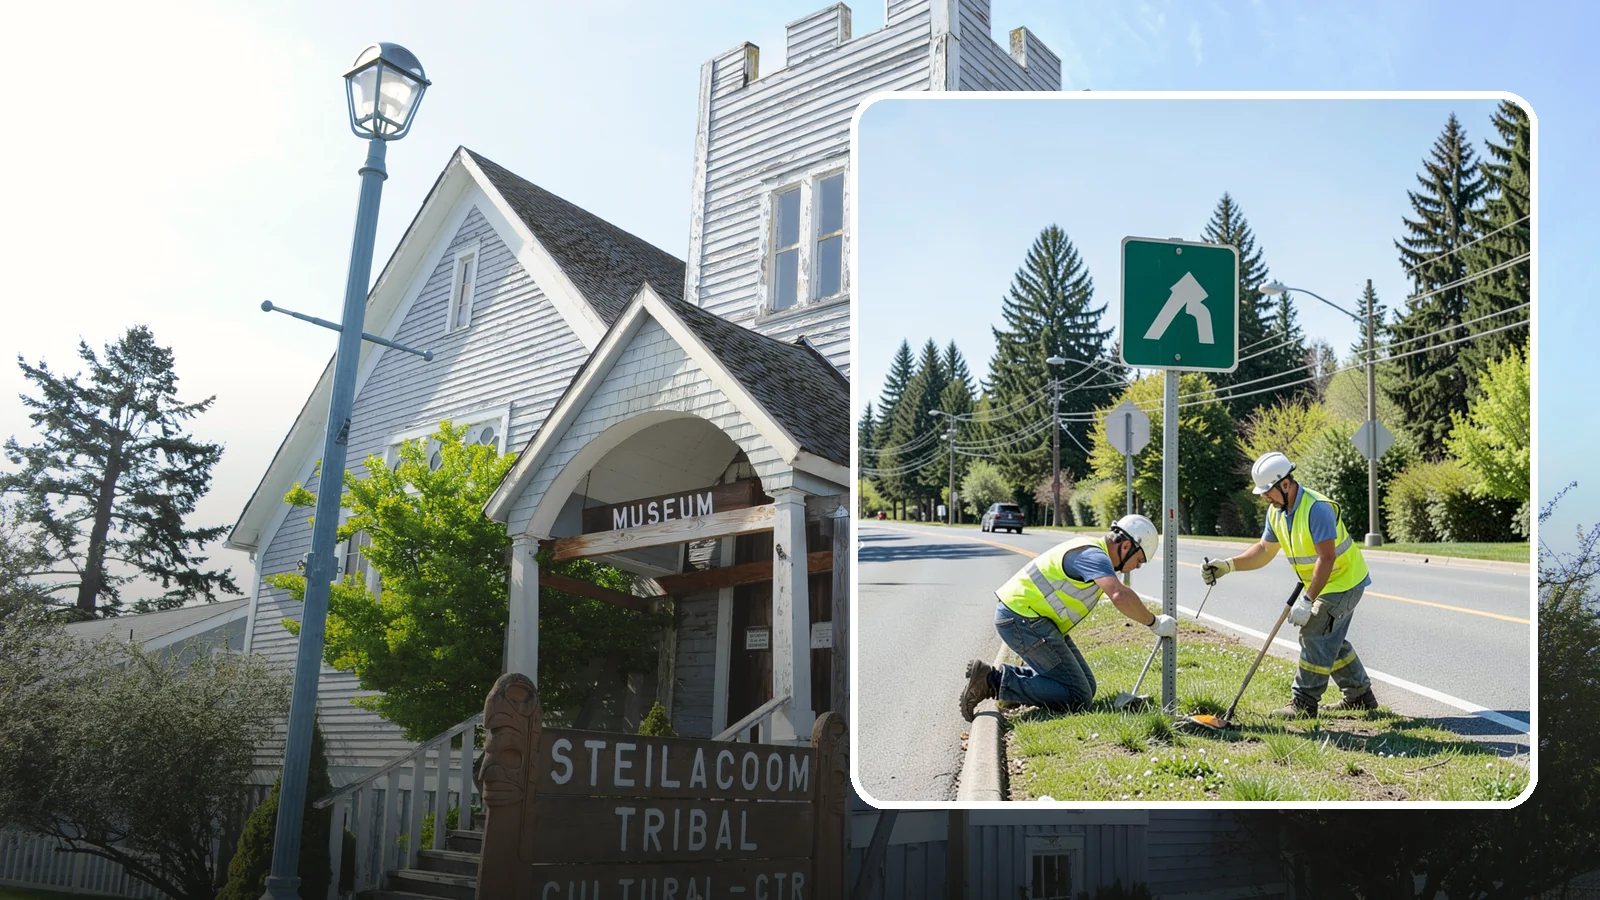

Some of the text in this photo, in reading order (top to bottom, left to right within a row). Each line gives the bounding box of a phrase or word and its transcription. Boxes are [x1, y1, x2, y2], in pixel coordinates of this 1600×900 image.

[613, 491, 713, 531] MUSEUM
[551, 738, 809, 792] STEILACOOM
[615, 806, 757, 851] TRIBAL
